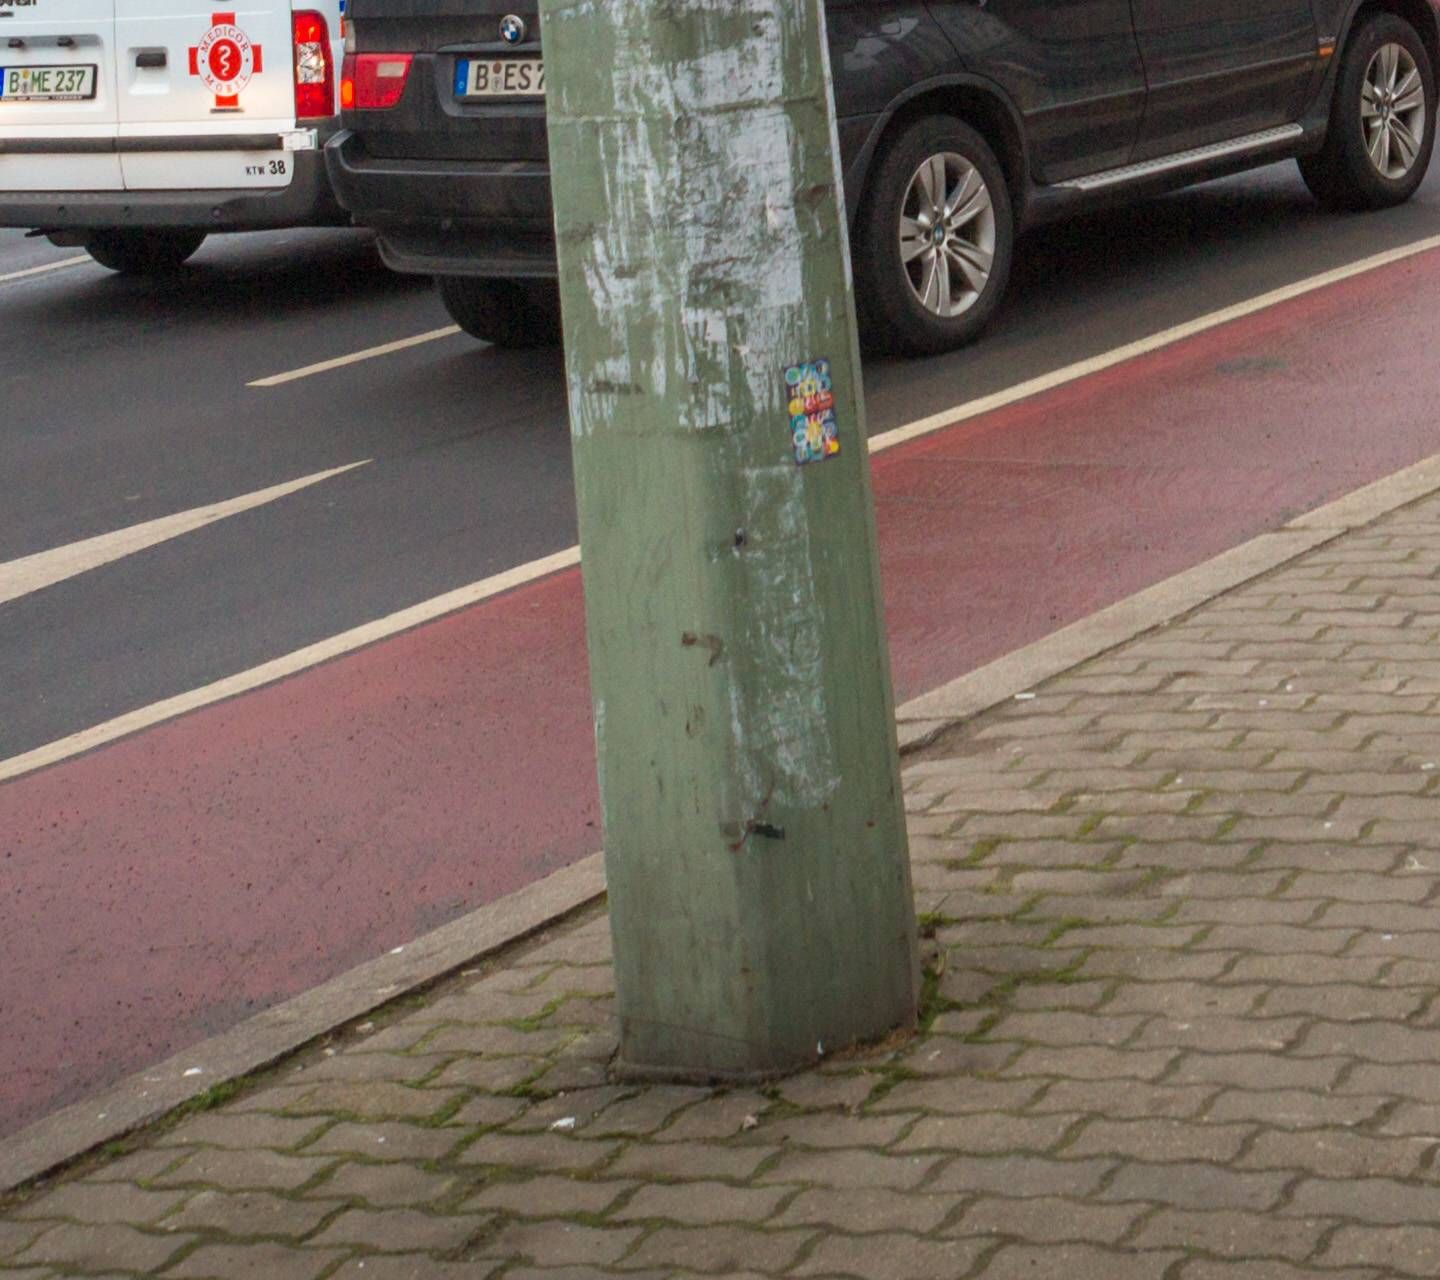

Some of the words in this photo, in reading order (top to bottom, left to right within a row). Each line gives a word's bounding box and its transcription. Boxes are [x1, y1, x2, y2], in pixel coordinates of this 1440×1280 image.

[200, 25, 250, 54] MEDICOR
[9, 71, 20, 93] B
[30, 70, 51, 93] ME
[54, 69, 86, 92] 237
[204, 72, 248, 94] MOBIL
[475, 63, 489, 91] B
[504, 63, 533, 91] ES
[268, 159, 287, 176] 38
